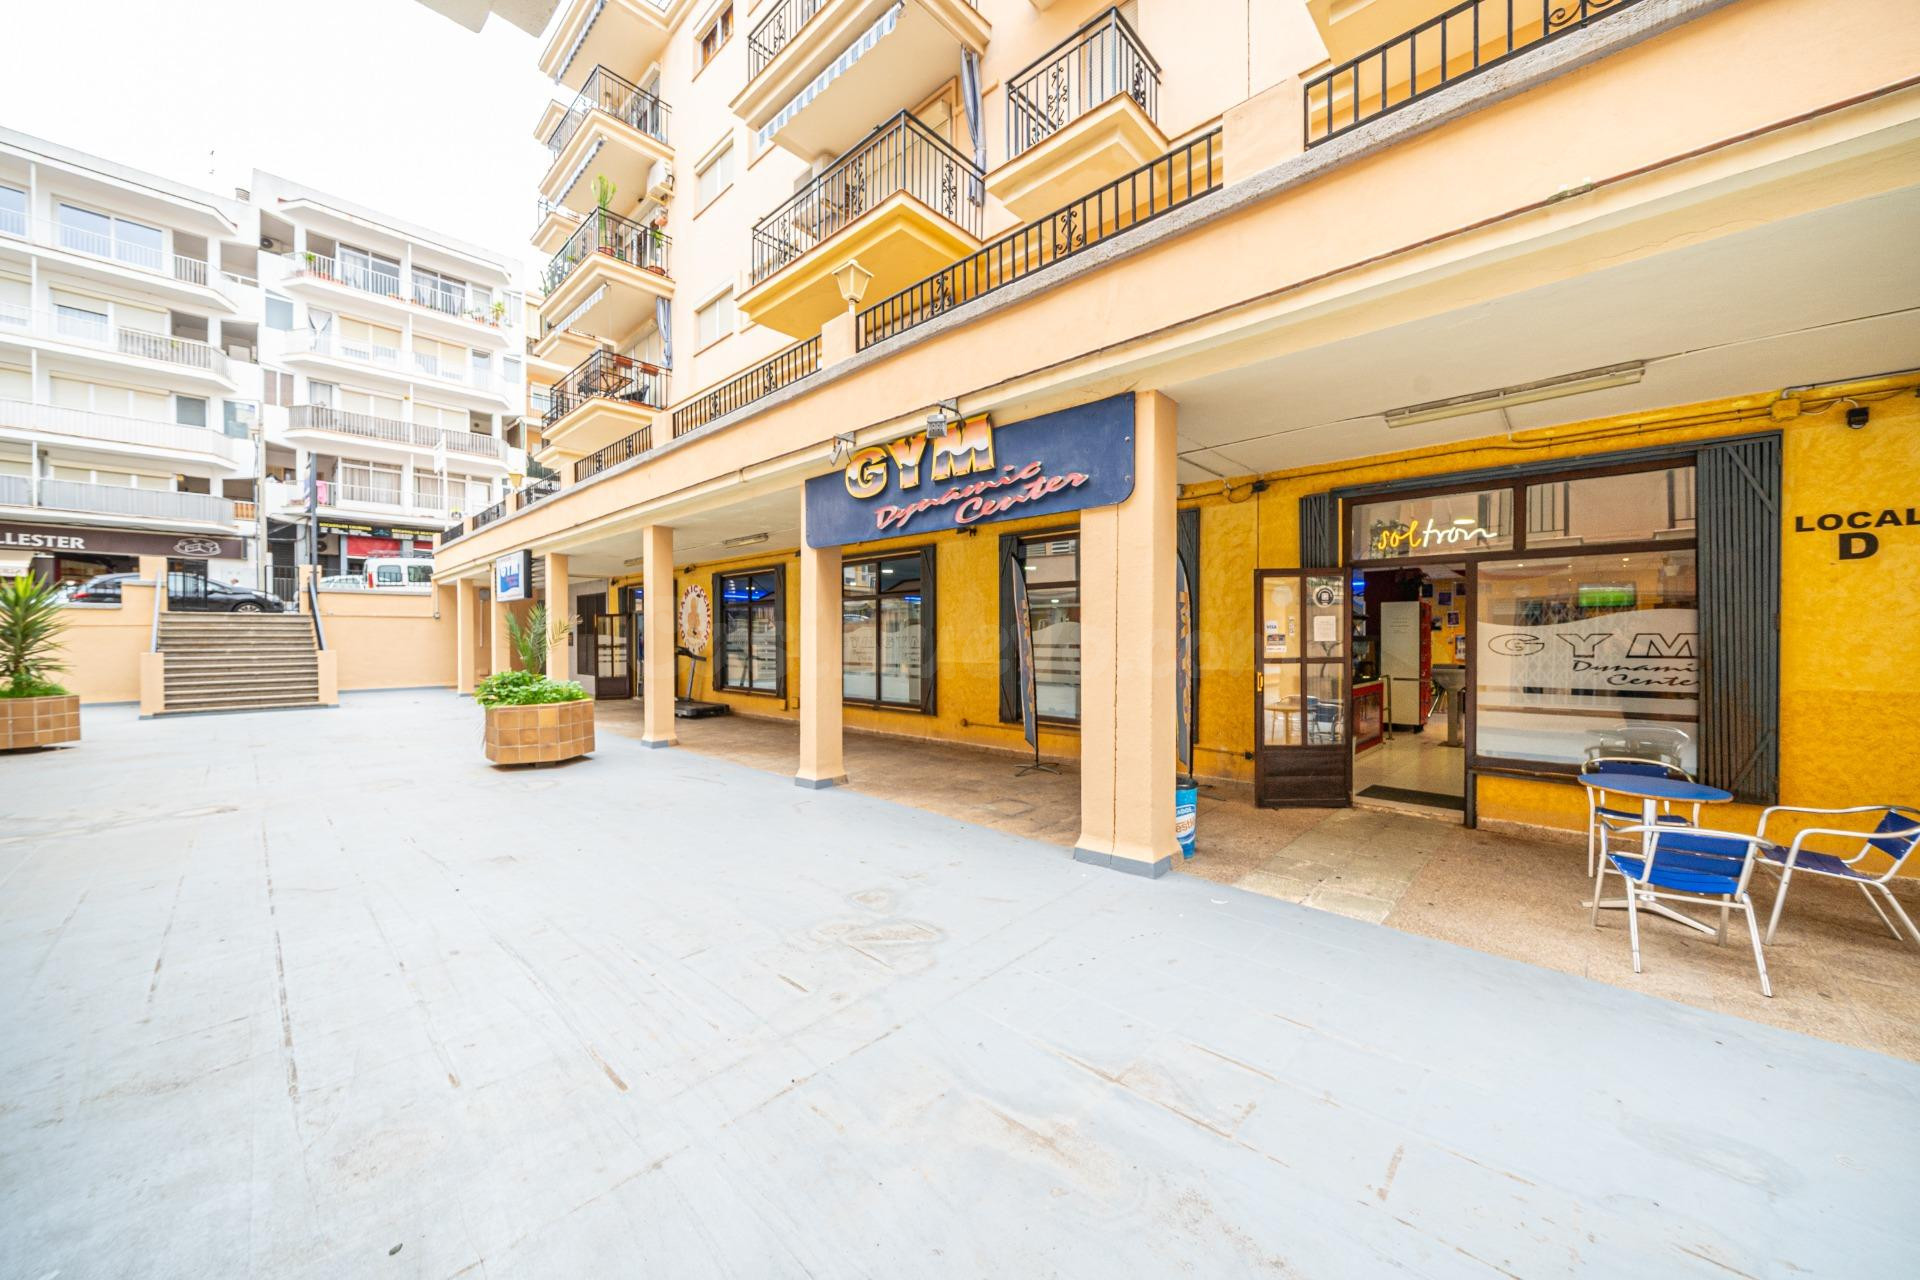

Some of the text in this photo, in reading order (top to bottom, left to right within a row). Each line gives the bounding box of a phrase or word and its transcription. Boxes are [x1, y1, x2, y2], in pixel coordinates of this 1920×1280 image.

[845, 413, 996, 499] GYM
[875, 460, 1042, 530] Dynamic
[955, 472, 1090, 525] Center
[1795, 507, 1920, 532] LOCAL
[0, 532, 86, 549] LESTER
[1838, 532, 1879, 560] D
[1487, 632, 1700, 658] GYM
[1572, 660, 1700, 672] Dynami
[1606, 674, 1700, 686] Cente
